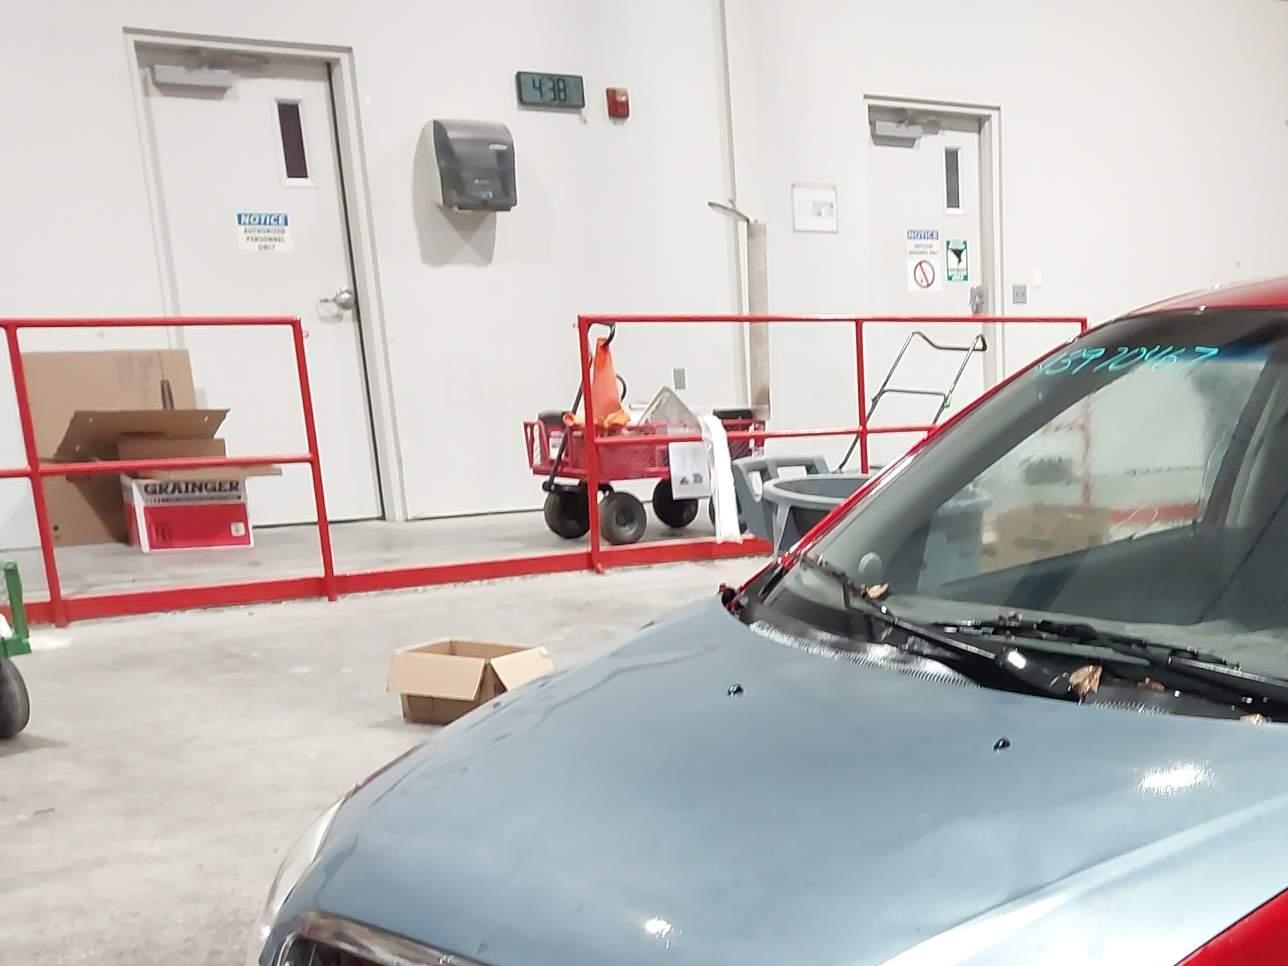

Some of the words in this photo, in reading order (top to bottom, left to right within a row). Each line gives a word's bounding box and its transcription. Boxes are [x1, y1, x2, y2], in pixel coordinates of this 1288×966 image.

[240, 213, 286, 226] NOTICE
[243, 227, 286, 235] AUTHORIZED
[908, 229, 939, 241] NOTICE
[143, 481, 240, 495] GRAINGER
